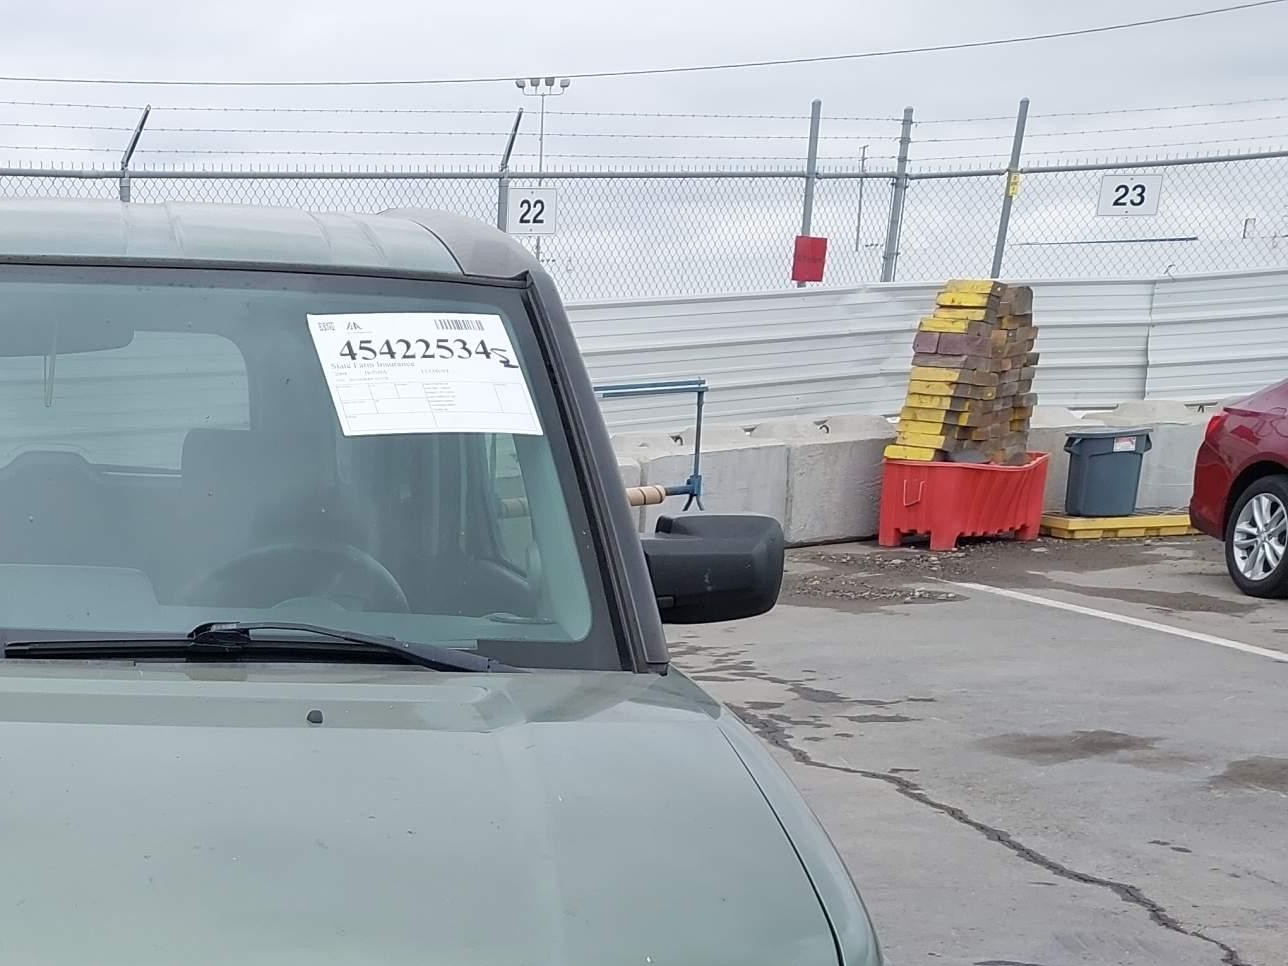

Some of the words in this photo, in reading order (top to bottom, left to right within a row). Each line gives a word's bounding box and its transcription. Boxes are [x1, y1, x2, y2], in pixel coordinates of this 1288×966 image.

[1112, 184, 1146, 206] 23
[519, 199, 545, 224] 22
[340, 338, 492, 360] 45422534
